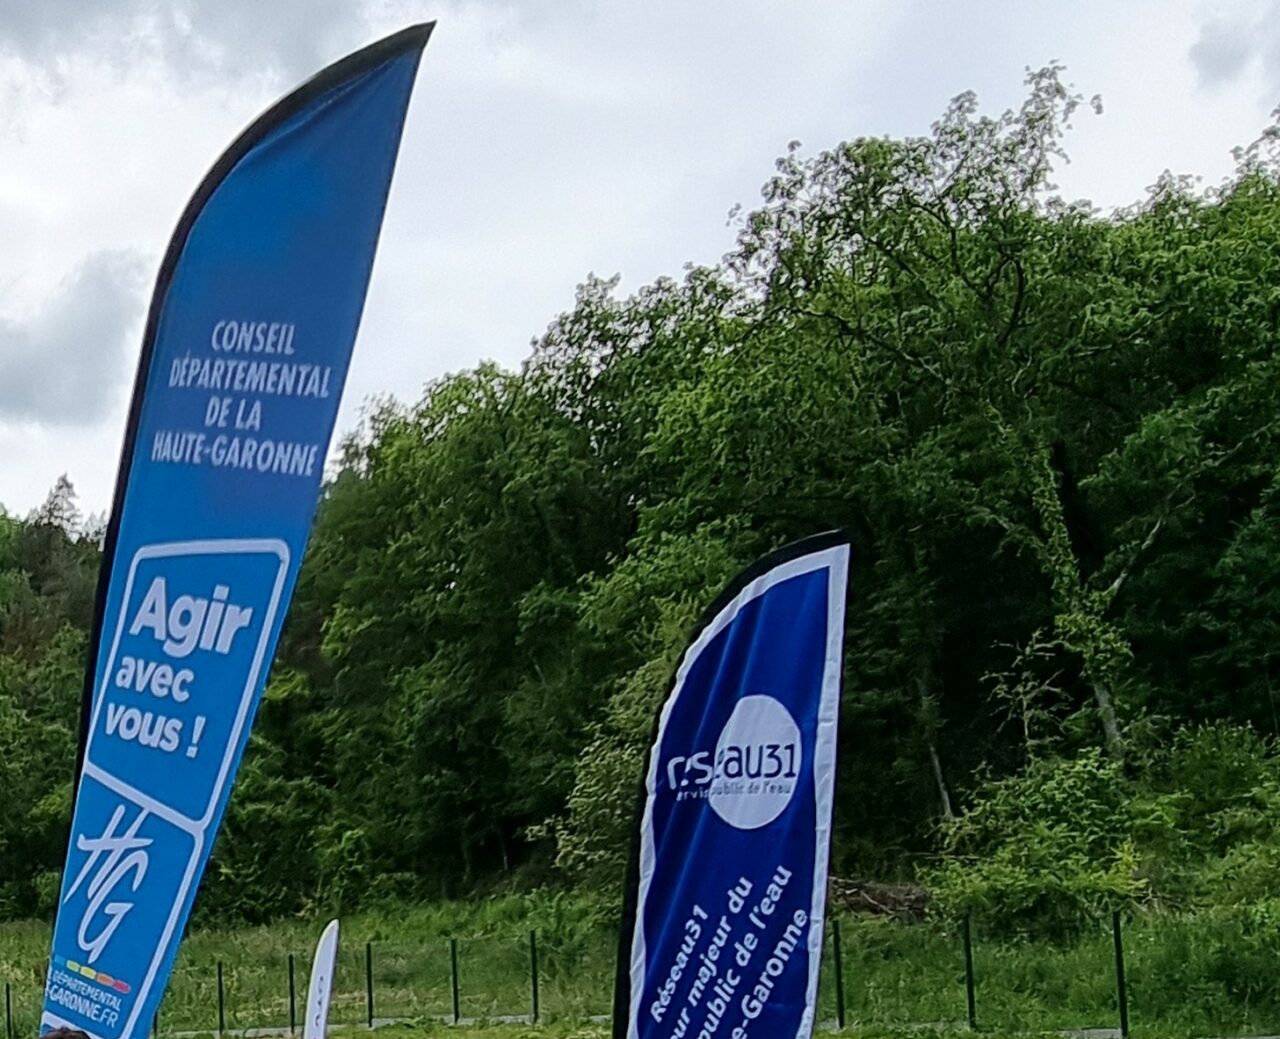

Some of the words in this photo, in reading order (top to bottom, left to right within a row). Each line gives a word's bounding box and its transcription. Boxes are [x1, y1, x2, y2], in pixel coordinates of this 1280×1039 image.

[211, 320, 296, 355] CONSEIL
[168, 350, 332, 398] DÉPARTEMENTAL
[204, 396, 230, 428] DE
[235, 399, 262, 432] LA
[151, 431, 320, 477] HAUTE-GARONNE
[129, 576, 254, 658] Agir
[115, 655, 195, 702] avec
[104, 701, 183, 752] vous
[735, 932, 759, 967] de
[748, 864, 793, 929] l'eau
[650, 903, 709, 1024] Réseau31
[687, 915, 732, 1008] majeur
[726, 876, 753, 915] du
